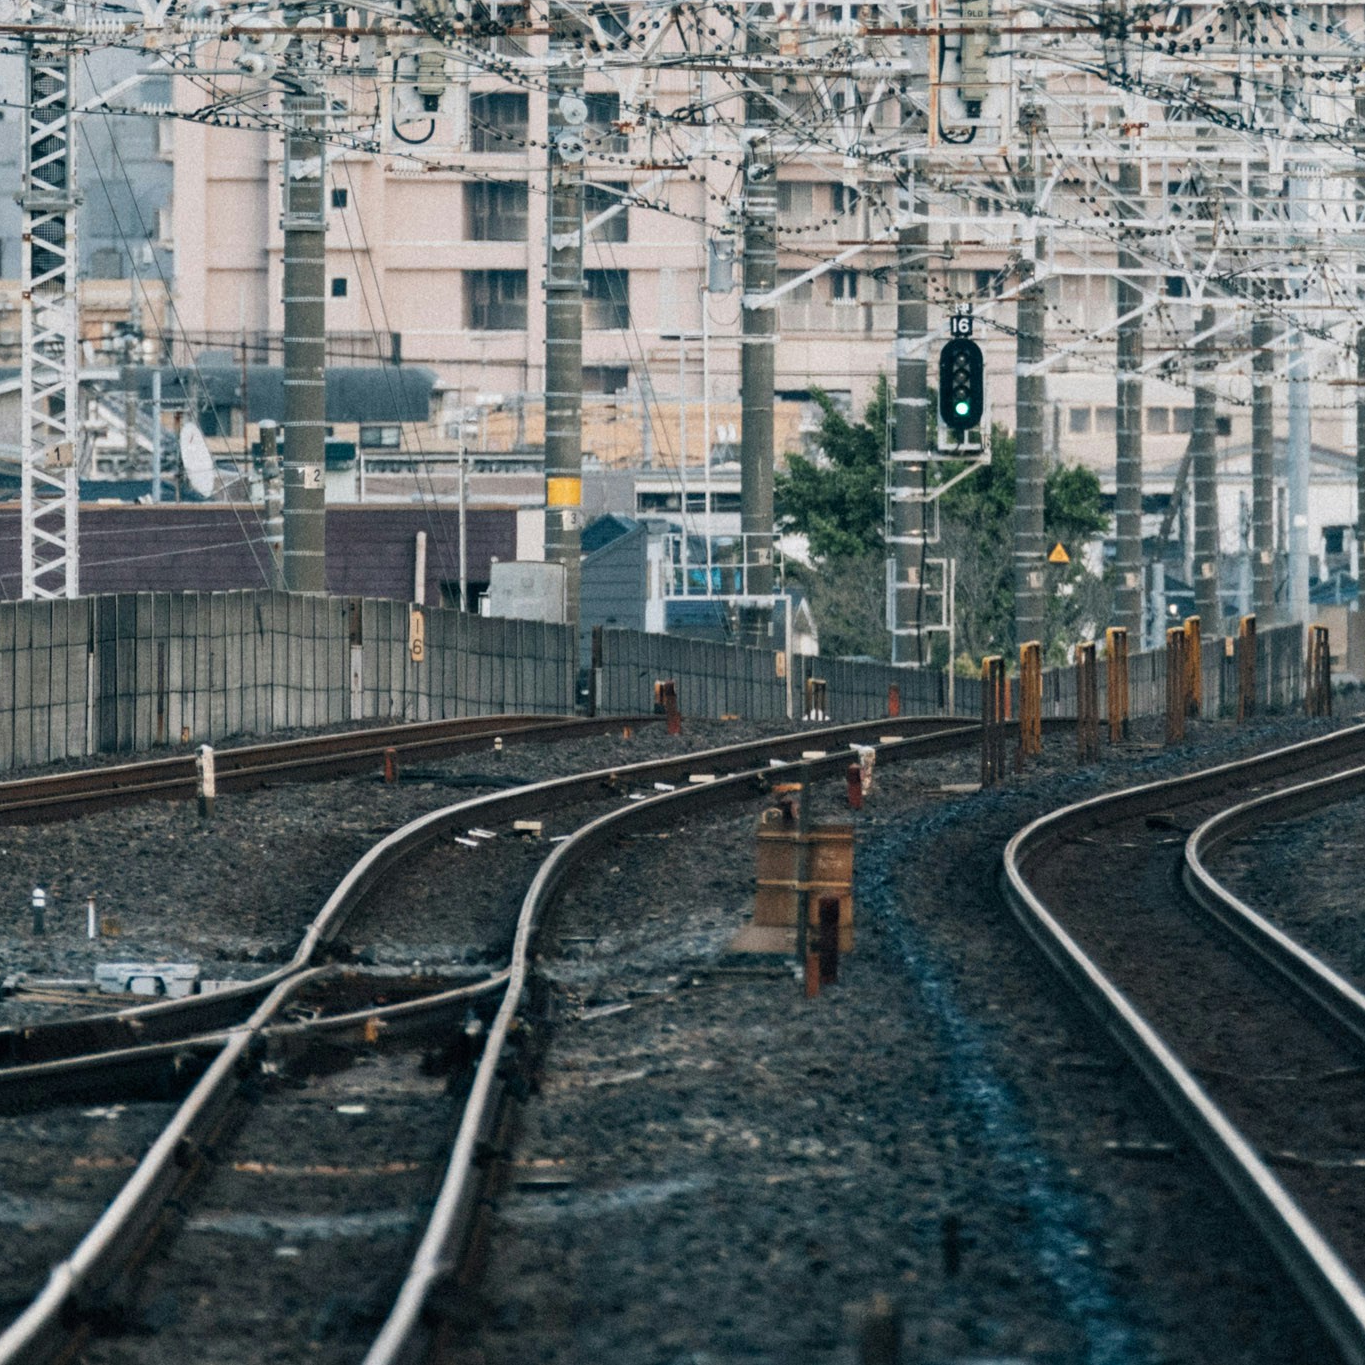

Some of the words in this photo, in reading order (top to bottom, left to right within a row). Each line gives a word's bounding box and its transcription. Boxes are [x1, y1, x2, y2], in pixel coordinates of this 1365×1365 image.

[953, 318, 969, 333] 16
[54, 447, 60, 461] 1
[314, 469, 321, 482] 2
[571, 513, 577, 524] 3
